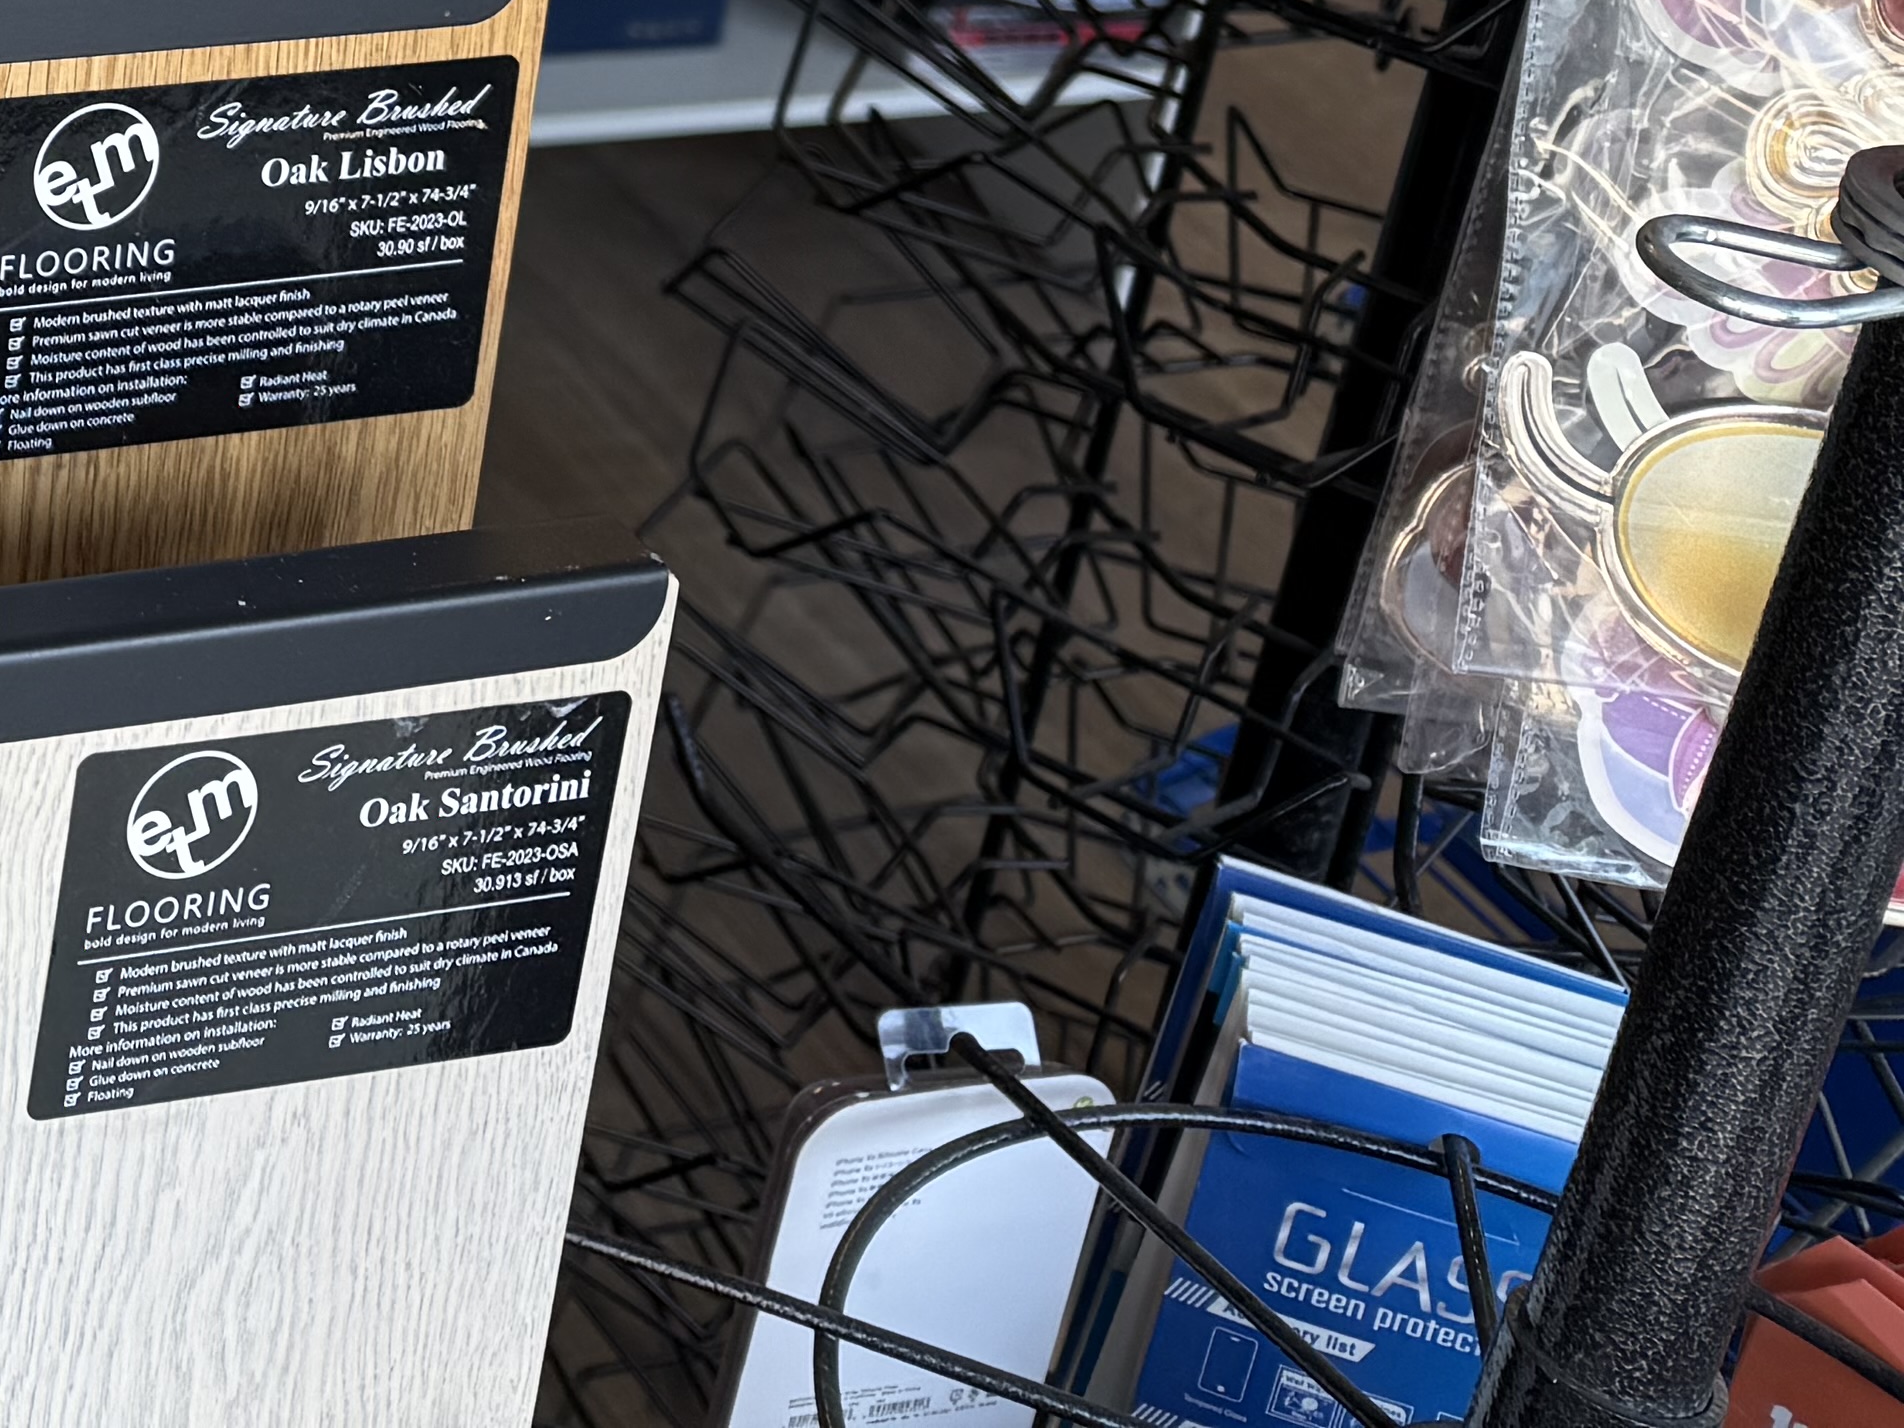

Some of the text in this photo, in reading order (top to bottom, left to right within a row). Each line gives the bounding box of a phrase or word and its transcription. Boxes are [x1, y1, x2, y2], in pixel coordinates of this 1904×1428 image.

[195, 83, 492, 149] Signature Brushed
[260, 146, 445, 188] Oak Lisbon
[348, 209, 467, 238] SKU: FE-2023-OL
[376, 237, 415, 257] 30.90
[415, 235, 431, 253] sf
[439, 234, 465, 251] box
[28, 338, 345, 384] This product has first class precise milling and finishing
[296, 715, 604, 792] Signature Brushed
[358, 768, 592, 828] Oak Santorini
[440, 840, 579, 876] SKU: FE-2023-OSA
[472, 871, 522, 894] 30.913
[524, 868, 540, 887] sf
[548, 866, 576, 883] box
[85, 882, 271, 934] FLOORING
[83, 915, 266, 951] bold design for modern living
[119, 926, 408, 980] Modern brushed texture with matt lacquer finish
[1263, 1270, 1366, 1321] screen
